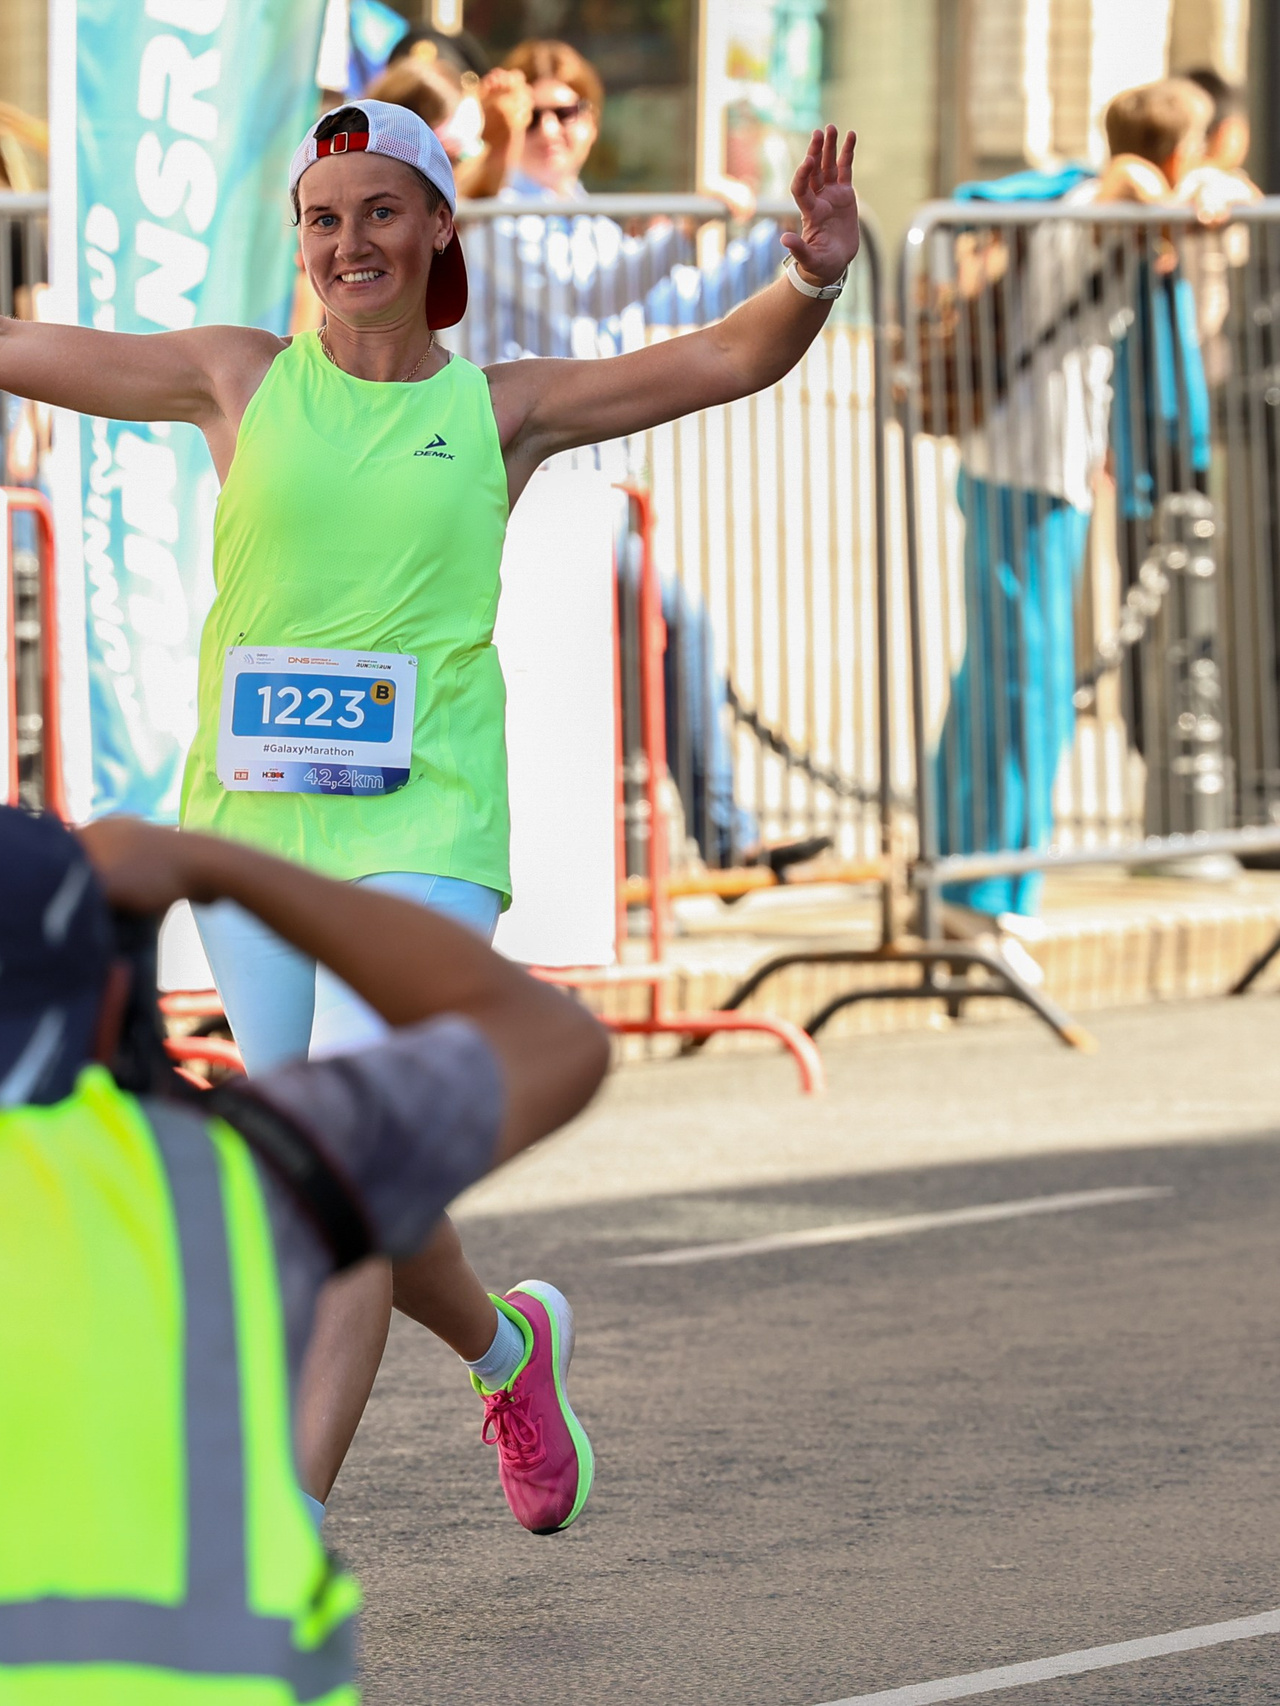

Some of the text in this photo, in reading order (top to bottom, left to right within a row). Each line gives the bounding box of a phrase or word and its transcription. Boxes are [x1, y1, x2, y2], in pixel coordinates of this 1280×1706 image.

[413, 450, 456, 460] DEMIX
[287, 656, 310, 665] DNS
[375, 685, 389, 699] B
[257, 685, 366, 729] 1223
[263, 743, 354, 757] #GalaxyMarathon
[303, 767, 384, 790] 42,2km
